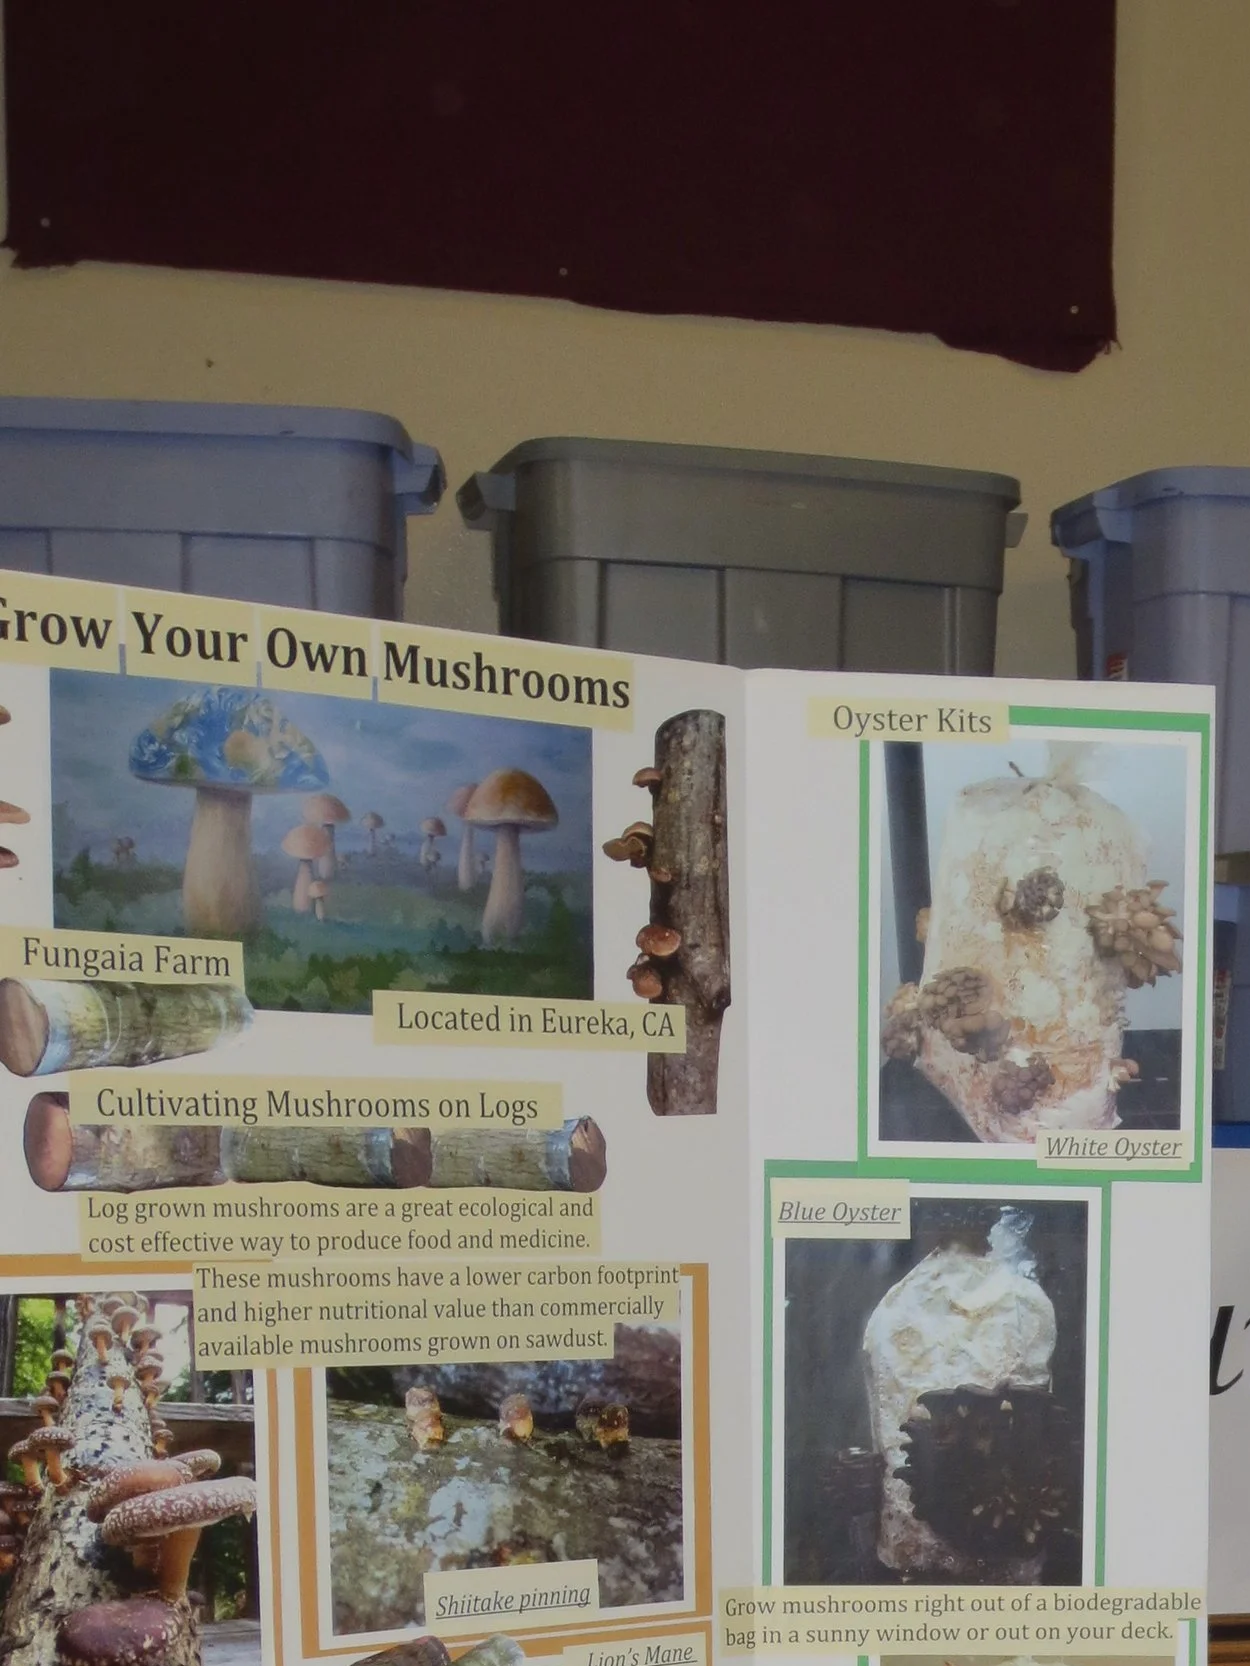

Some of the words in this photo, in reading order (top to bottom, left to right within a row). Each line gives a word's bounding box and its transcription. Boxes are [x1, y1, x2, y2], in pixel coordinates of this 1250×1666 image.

[132, 611, 249, 662] Your
[267, 627, 368, 678] Own
[384, 641, 631, 709] Mushrooms
[834, 705, 928, 737] Oyster
[938, 708, 992, 734] Kits
[23, 938, 144, 978] Fungaia
[155, 947, 231, 977] Farm
[397, 1002, 501, 1033] Located
[509, 1007, 533, 1033] in
[541, 1008, 635, 1040] Eureka,
[642, 1011, 675, 1038] CA
[97, 1088, 258, 1124] Cultivating
[267, 1090, 431, 1120] Mushrooms
[439, 1098, 471, 1119] on
[479, 1092, 539, 1124] Logs
[1046, 1137, 1108, 1158] White
[1114, 1137, 1183, 1162] Oyster
[88, 1197, 128, 1224] Log
[135, 1202, 206, 1224] grown
[213, 1197, 340, 1218] mushrooms
[346, 1201, 379, 1217] are
[385, 1203, 395, 1217] a
[401, 1200, 453, 1222] great
[459, 1197, 553, 1222] ecological
[559, 1197, 594, 1217] and
[778, 1201, 827, 1223] Blue
[833, 1202, 902, 1226] Oyster
[89, 1234, 135, 1253] cost
[141, 1231, 234, 1252] effective
[240, 1237, 284, 1257] way
[291, 1233, 311, 1250] to
[316, 1230, 402, 1256] produce
[408, 1229, 452, 1250] food
[457, 1229, 493, 1249] and
[500, 1228, 591, 1249] medicine.
[196, 1267, 261, 1288] These
[268, 1267, 391, 1288] mushrooms
[397, 1267, 444, 1286] have
[450, 1272, 460, 1286] a
[467, 1267, 522, 1286] lower
[527, 1266, 592, 1285] carbon
[597, 1265, 680, 1289] footprint
[198, 1302, 238, 1323] and
[243, 1301, 313, 1327] higher
[319, 1299, 428, 1321] nutritional
[434, 1298, 486, 1319] value
[492, 1297, 534, 1317] than
[540, 1295, 665, 1319] commercially
[198, 1334, 293, 1357] available
[300, 1332, 422, 1355] mushrooms
[428, 1335, 491, 1357] grown
[497, 1334, 520, 1350] on
[526, 1328, 608, 1348] sawdust.
[436, 1588, 514, 1618] Shiitake
[518, 1583, 592, 1615] pinning
[725, 1598, 776, 1617] Grow
[783, 1595, 908, 1614] mushrooms
[914, 1594, 965, 1617] right
[970, 1595, 1005, 1611] out
[1011, 1593, 1033, 1611] of
[1036, 1598, 1048, 1611] a
[1054, 1592, 1201, 1615] biodegradable
[725, 1628, 756, 1649] bag
[762, 1626, 782, 1643] in
[789, 1631, 800, 1643] a
[806, 1628, 870, 1647] sunny
[876, 1623, 961, 1642] window
[967, 1627, 990, 1641] or
[995, 1624, 1030, 1640] out
[1041, 1626, 1060, 1640] on
[1066, 1625, 1115, 1644] your
[1121, 1622, 1174, 1639] deck.
